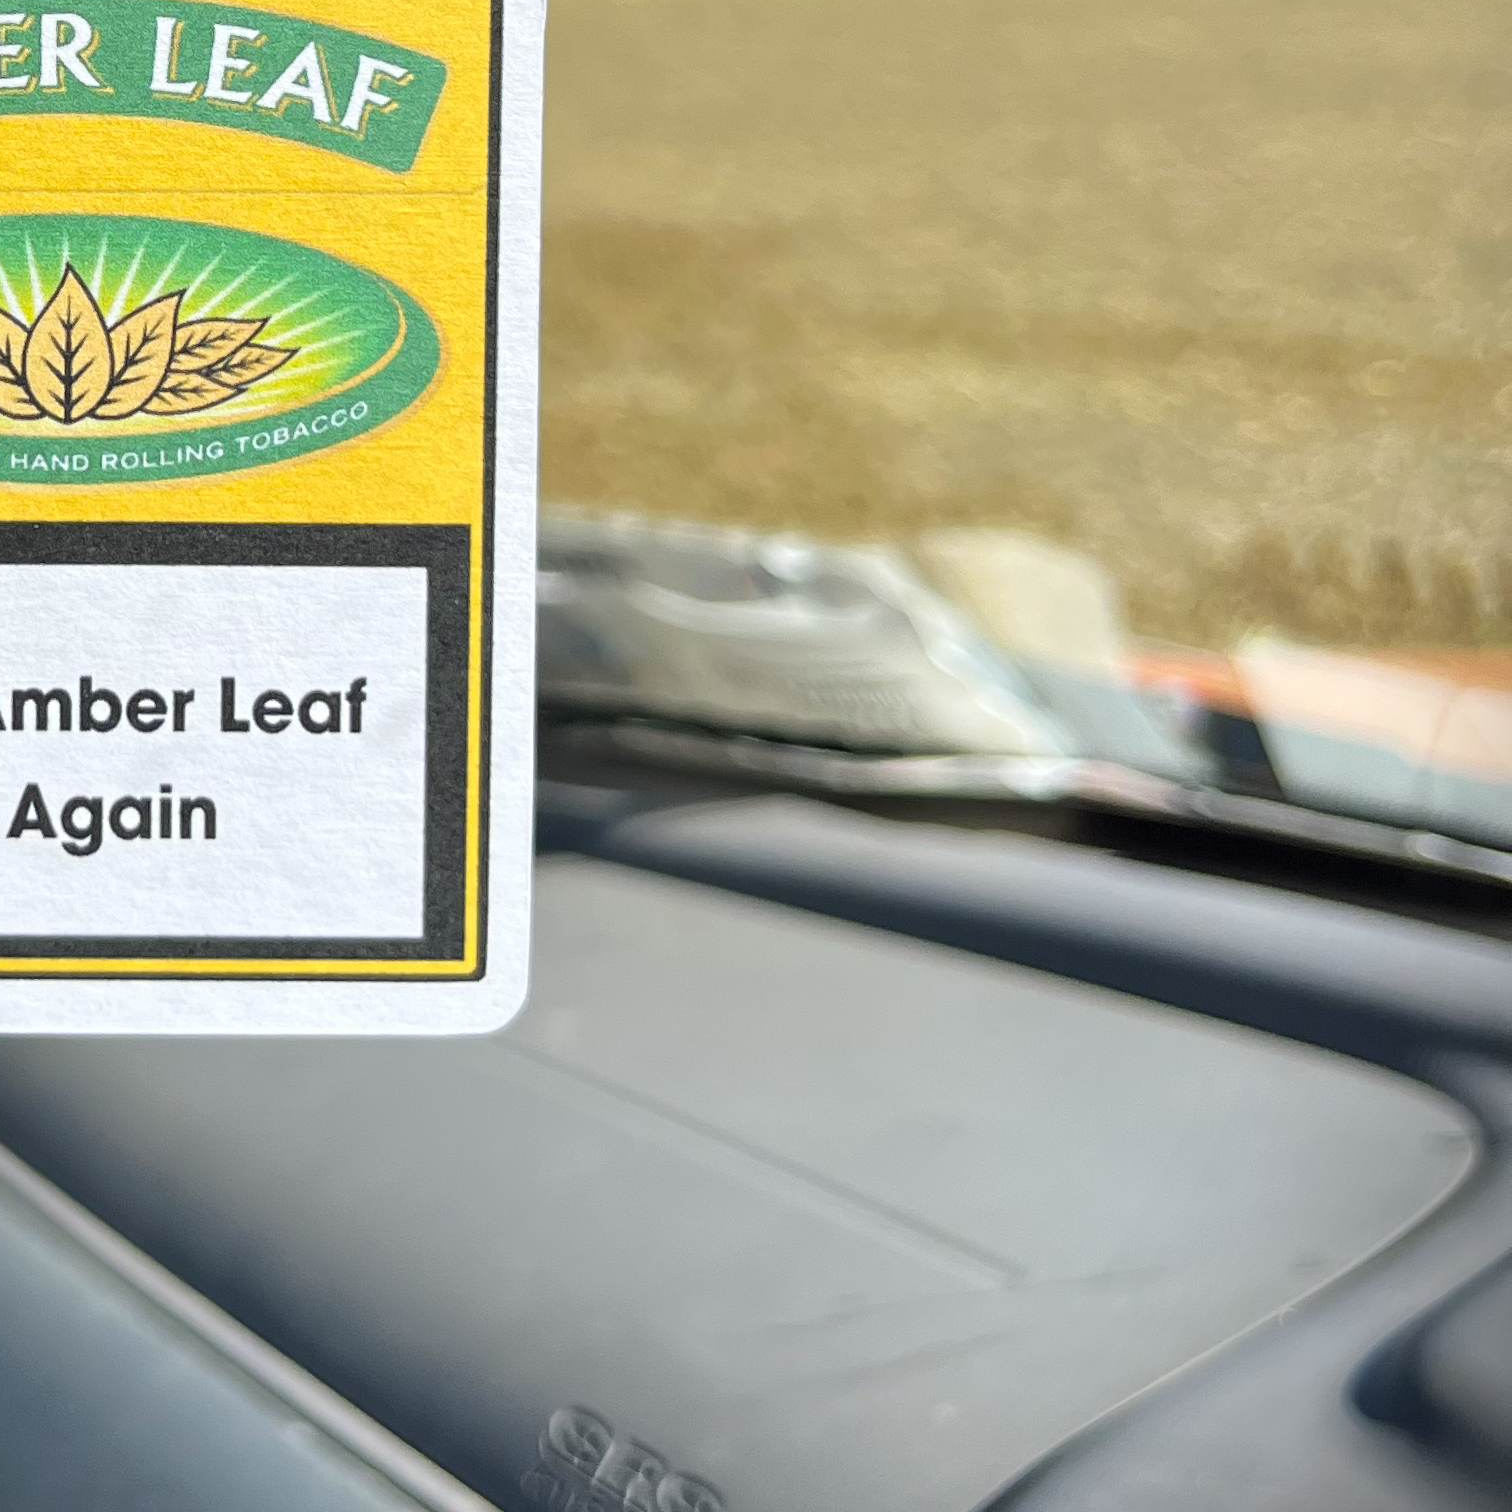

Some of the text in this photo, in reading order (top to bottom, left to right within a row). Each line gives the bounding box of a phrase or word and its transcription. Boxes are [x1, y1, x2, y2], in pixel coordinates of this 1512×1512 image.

[149, 15, 414, 140] LEAF
[10, 452, 89, 471] HAND
[101, 441, 224, 471] ROLLING
[234, 400, 368, 455] TOBACCO
[220, 677, 366, 734] Leaf
[6, 783, 217, 856] Again
